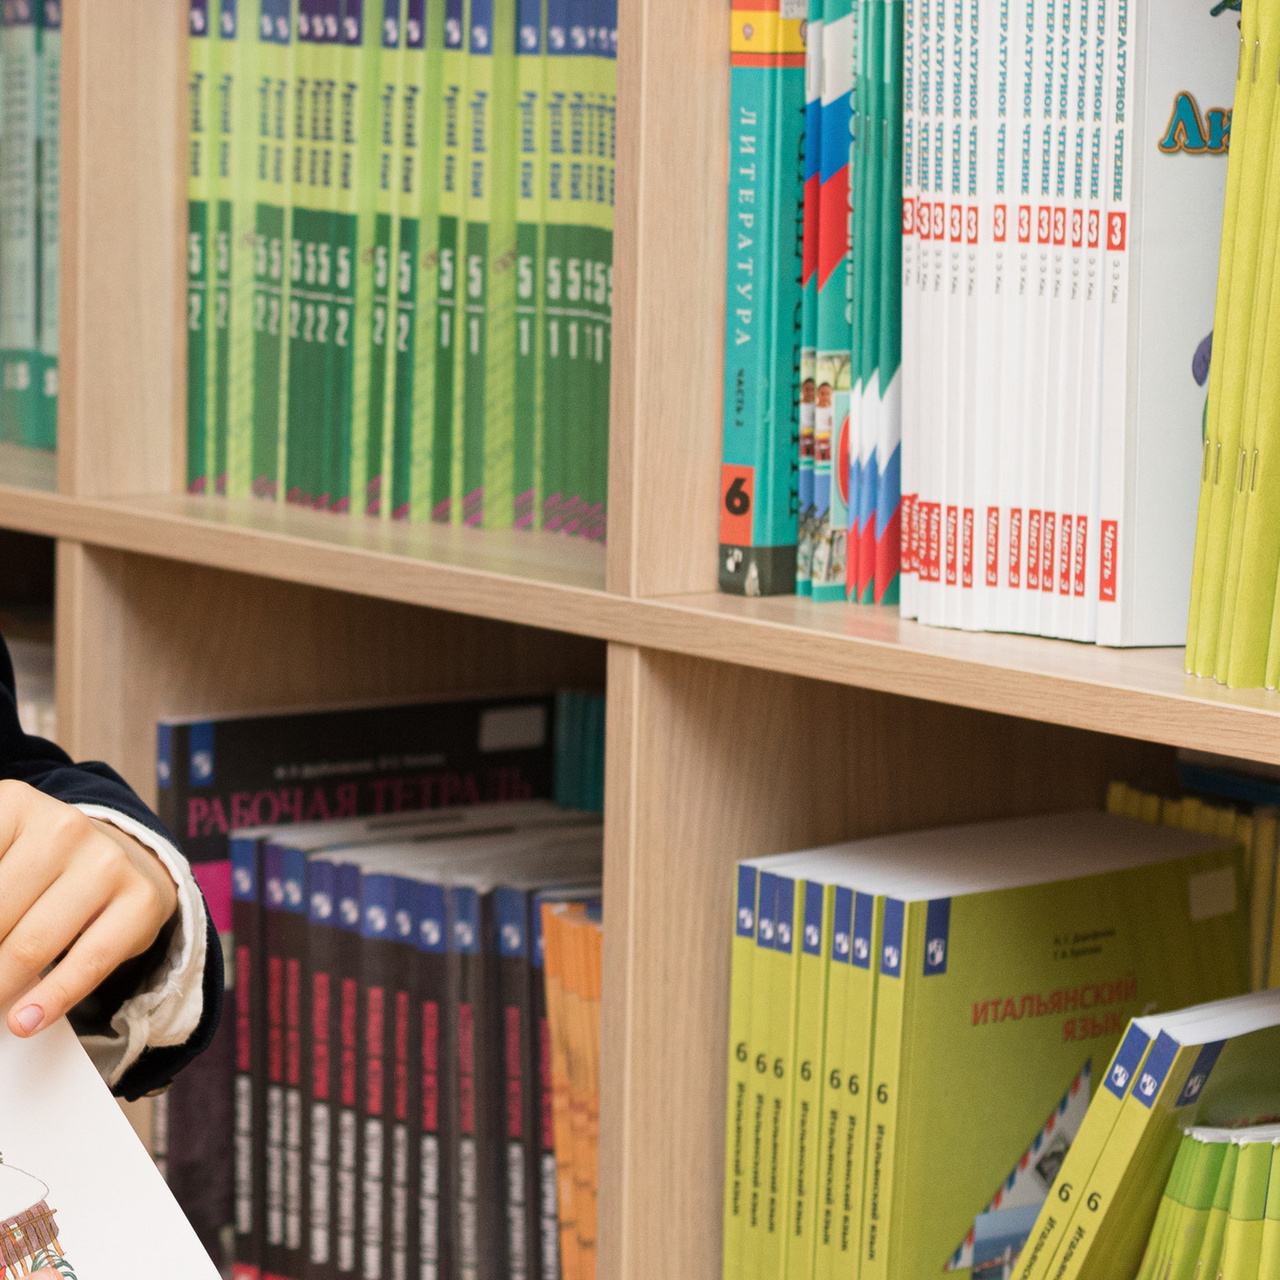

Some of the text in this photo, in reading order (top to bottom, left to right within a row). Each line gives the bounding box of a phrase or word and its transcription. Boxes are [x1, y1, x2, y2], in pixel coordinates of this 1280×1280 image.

[920, 121, 930, 193] ЧТЕНИЕ
[934, 121, 945, 193] ЧТЕНИЕ
[951, 123, 962, 196] ЧТЕНИЕ
[968, 125, 978, 197] ЧТЕНИЕ
[996, 123, 1008, 195] ЧТЕНИЕ
[1021, 124, 1032, 196] ЧТЕНИЕ
[1041, 124, 1052, 197] ЧТЕНИЕ
[1056, 125, 1067, 198] ЧТЕНИЕ
[1074, 127, 1085, 200] ЧТЕНИЕ
[1090, 127, 1101, 200] ЧТЕНИЕ
[1112, 128, 1124, 202] ЧТЕНИЕ
[733, 106, 758, 349] ЛИТЕРАТУРА
[903, 201, 913, 235] 3
[921, 205, 930, 238] 3
[934, 205, 944, 238] 3
[951, 207, 962, 240] 3
[968, 209, 978, 242] 3
[995, 206, 1006, 240] 3
[1020, 207, 1031, 241] 3
[1039, 208, 1052, 241] 3
[1055, 209, 1066, 243] 3
[1074, 212, 1083, 245] 3
[1089, 212, 1099, 246] 3
[1110, 214, 1123, 248] 3
[336, 246, 351, 289] 5
[439, 248, 455, 292] 5
[468, 255, 483, 300] 5
[518, 255, 533, 300] 5
[548, 257, 562, 300] 5
[724, 476, 751, 517] 6
[920, 507, 929, 560] Часть
[930, 508, 940, 560] Часть
[947, 511, 958, 564] Часть
[963, 514, 974, 566] Часть
[987, 512, 999, 564] Часть
[1010, 514, 1021, 567] Часть
[1030, 515, 1042, 567] Часть
[1045, 518, 1057, 569] Часть
[1061, 520, 1072, 574] Часть
[1076, 521, 1088, 575] Часть
[1103, 525, 1117, 582] Часть
[187, 781, 361, 839] РАБОЧАЯ
[970, 972, 1138, 1026] ИТАЛЬЯНСКИЙ
[735, 1042, 748, 1063] 6
[755, 1053, 767, 1075] 6
[773, 1057, 785, 1079] 6
[801, 1060, 812, 1082] 6
[829, 1068, 842, 1090] 6
[848, 1074, 860, 1096] 6
[876, 1083, 889, 1105] 6
[1058, 1182, 1074, 1203] 6
[1087, 1192, 1103, 1213] 6
